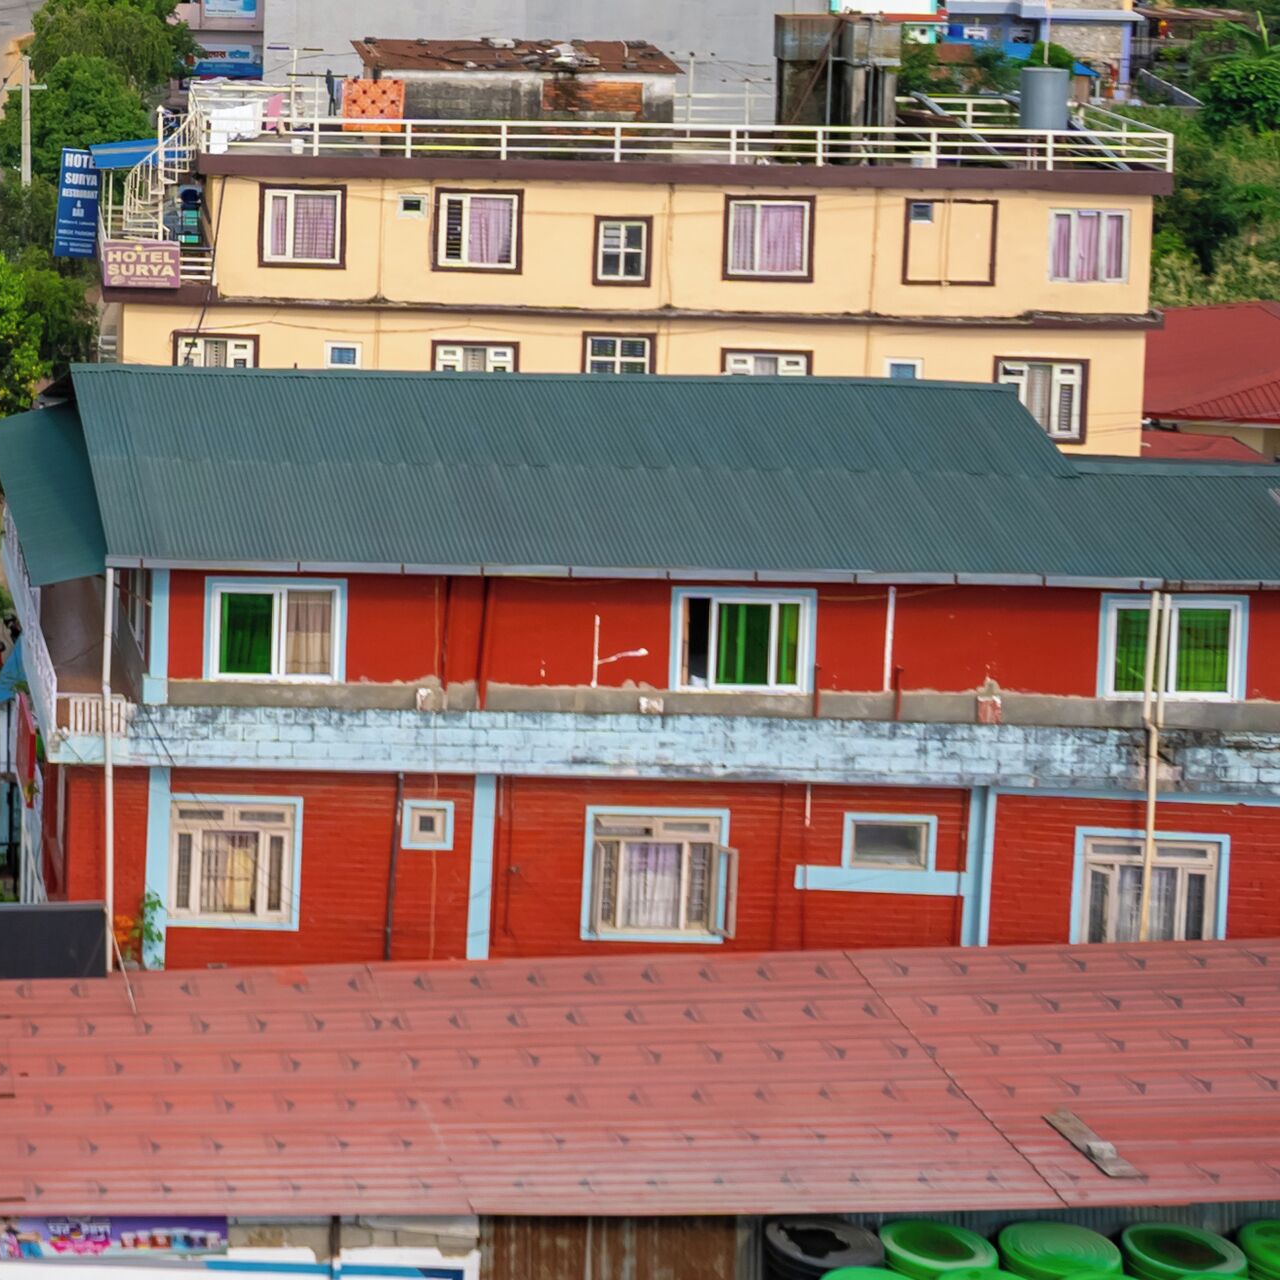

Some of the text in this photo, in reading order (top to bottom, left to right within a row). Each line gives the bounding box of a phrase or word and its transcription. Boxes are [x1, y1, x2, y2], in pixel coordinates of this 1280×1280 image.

[64, 153, 96, 169] HOTE
[64, 172, 98, 186] SURYA
[62, 188, 99, 199] RESTAURANT
[107, 251, 176, 264] HOTEL
[107, 263, 176, 277] SURYA
